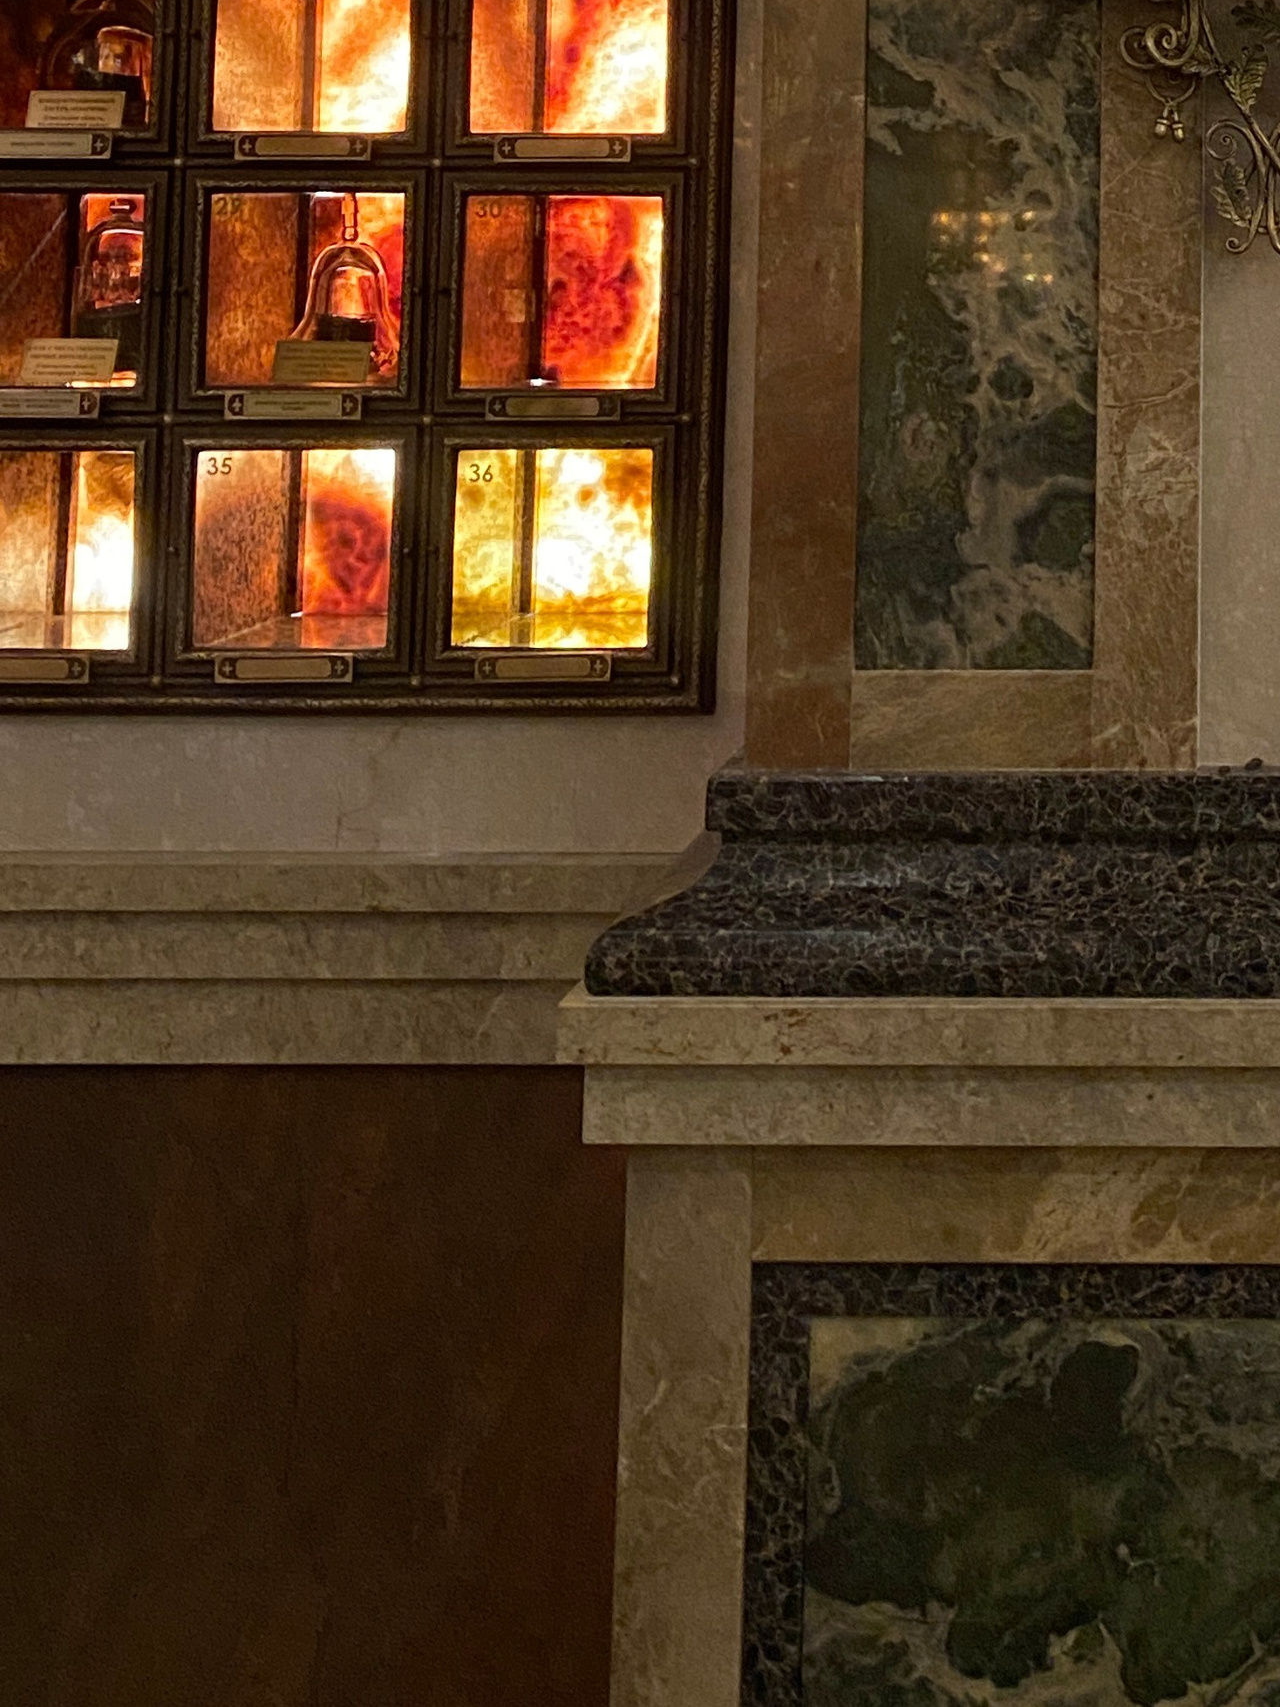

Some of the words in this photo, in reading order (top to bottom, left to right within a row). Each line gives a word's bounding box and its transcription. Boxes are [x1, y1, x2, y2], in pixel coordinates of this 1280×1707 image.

[475, 199, 502, 218] 30
[207, 457, 233, 476] 35
[469, 464, 494, 483] 36
